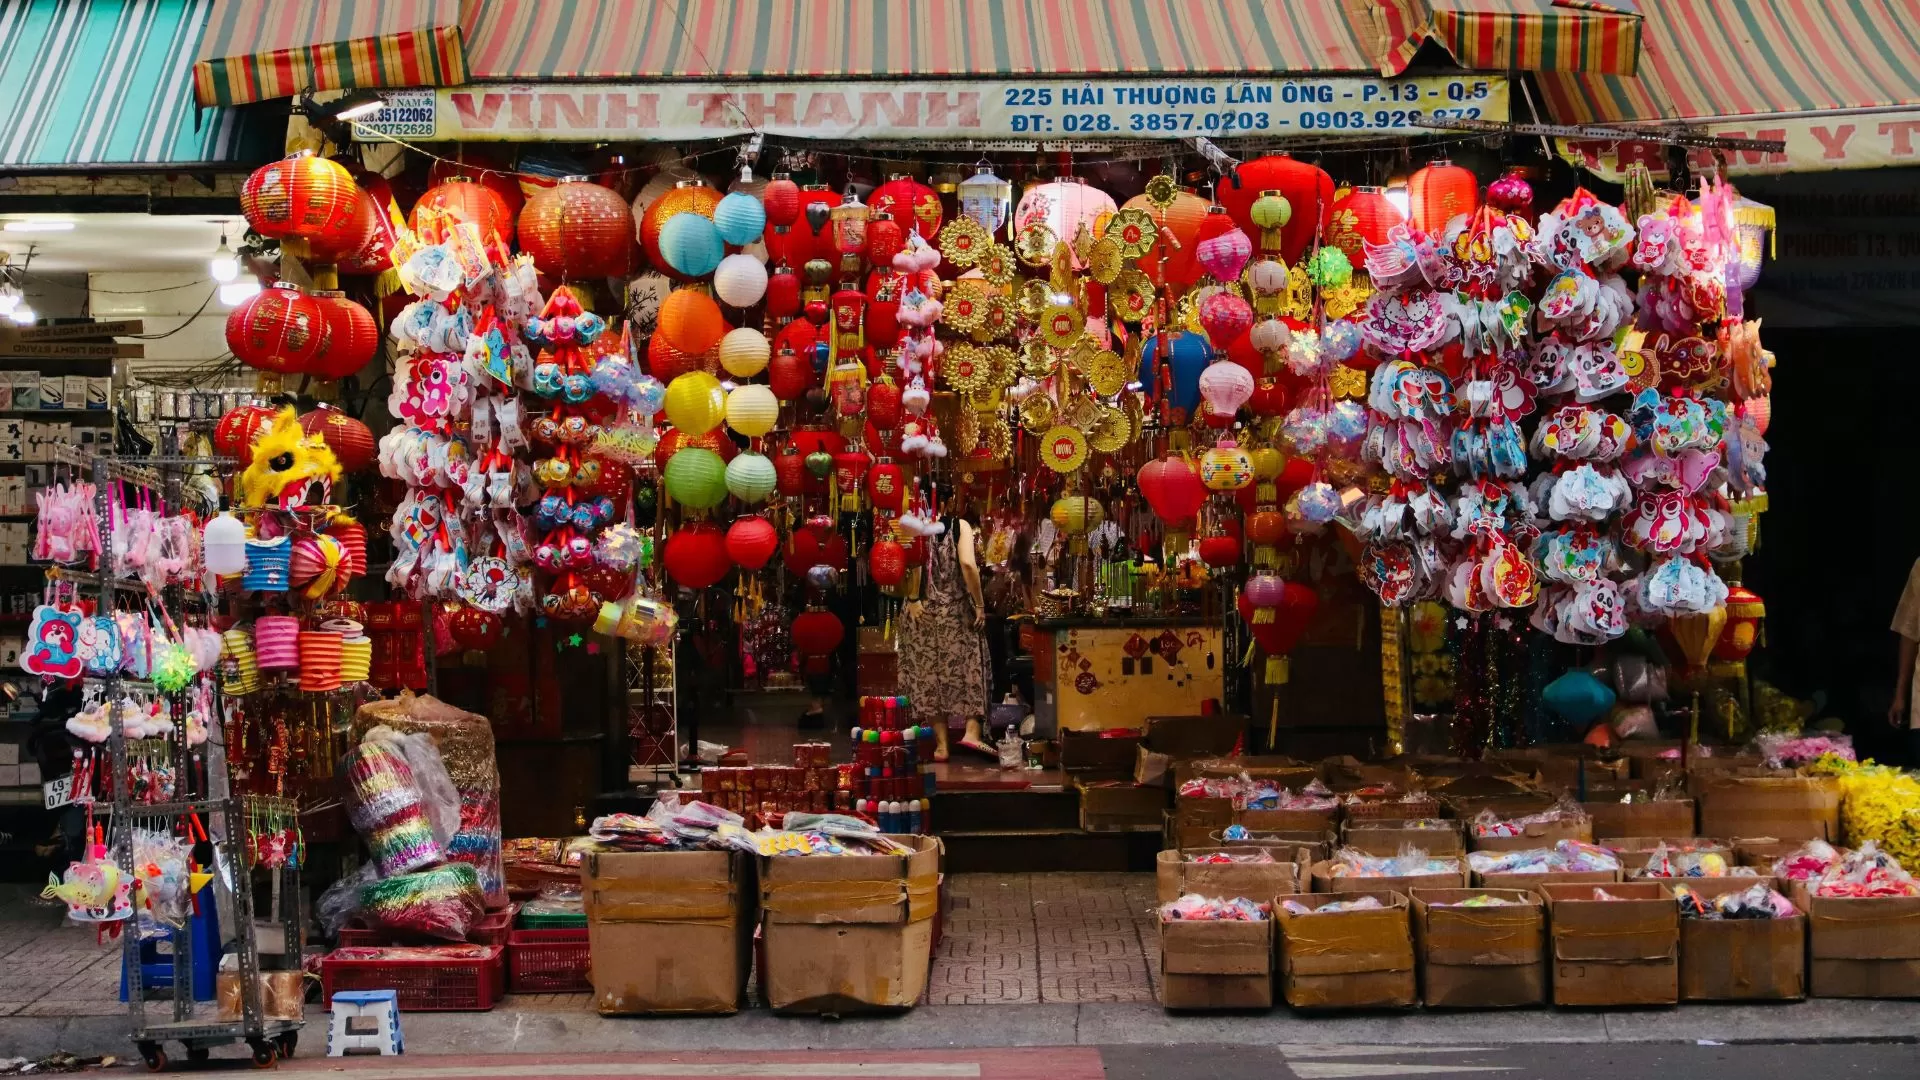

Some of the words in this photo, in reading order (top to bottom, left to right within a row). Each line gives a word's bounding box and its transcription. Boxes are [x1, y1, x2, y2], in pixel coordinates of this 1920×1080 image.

[1005, 88, 1051, 106] 225
[1062, 83, 1104, 105] HẢI
[1113, 85, 1216, 108] THƯỢNG
[1227, 82, 1272, 104] LÃN
[1282, 82, 1333, 103] ÔNG
[1363, 84, 1418, 103] P.13
[1447, 82, 1488, 102] Q.5
[397, 98, 421, 107] NAM
[1010, 114, 1053, 132] ĐT:
[1063, 114, 1120, 132] 028.
[1129, 111, 1270, 131] 3857.0203
[88, 324, 126, 333] STAND
[13, 344, 51, 353] STAND
